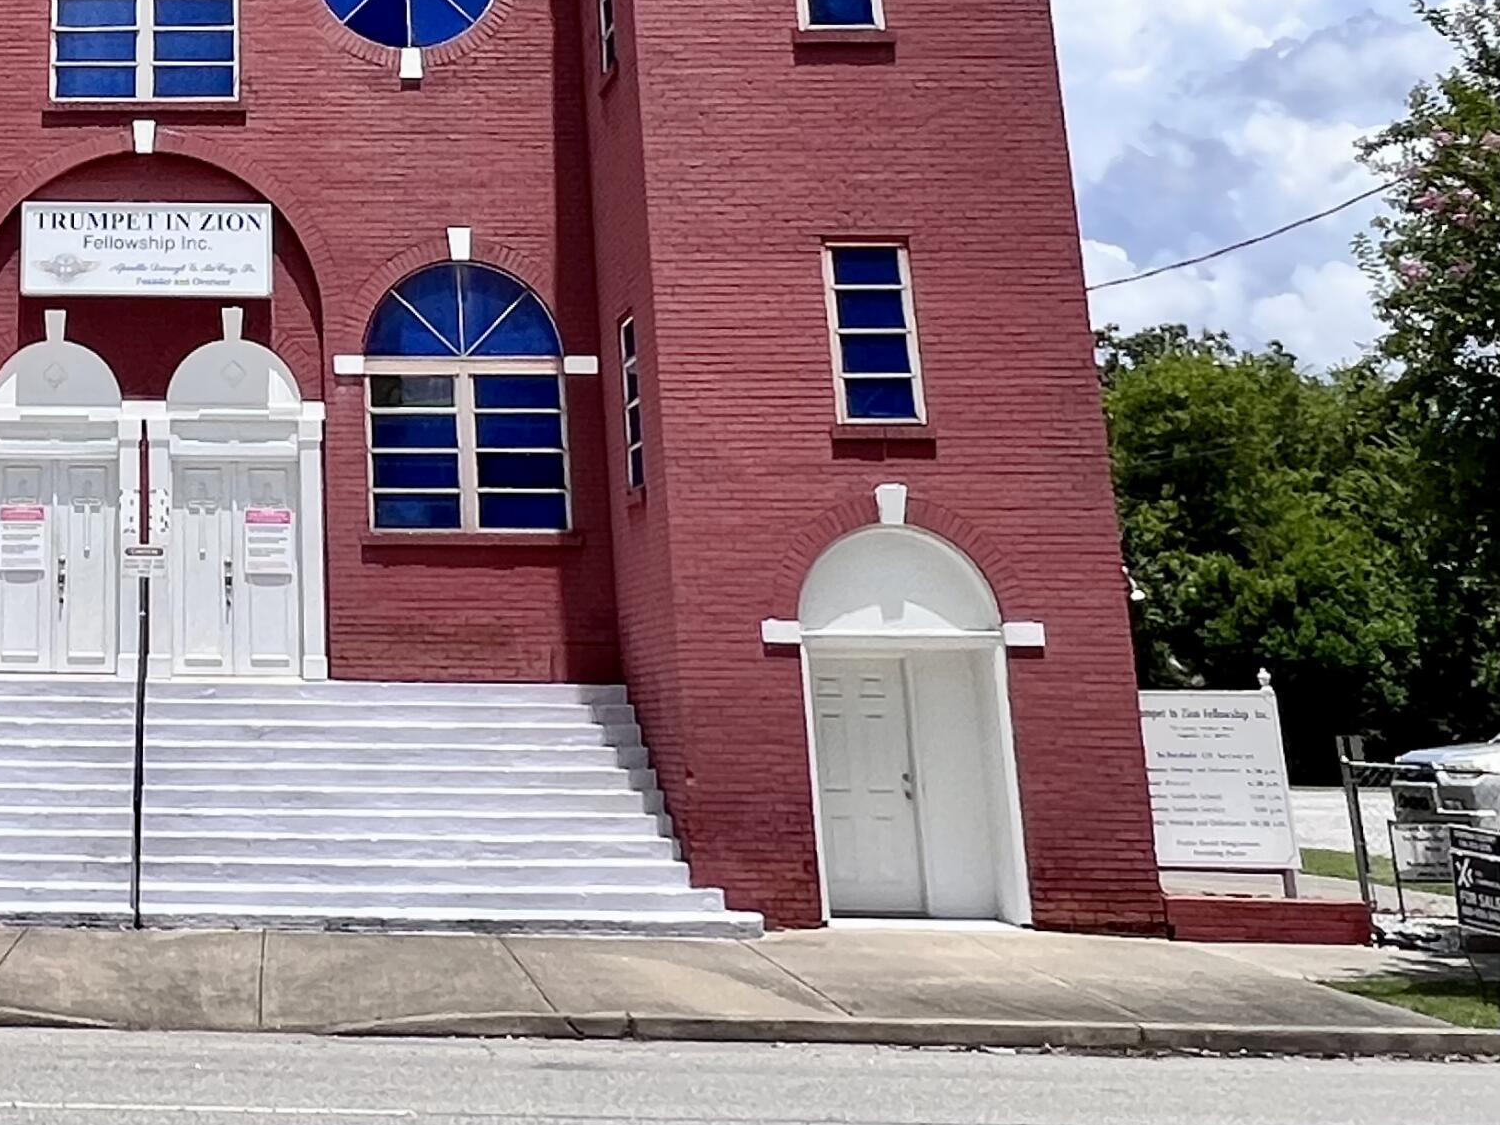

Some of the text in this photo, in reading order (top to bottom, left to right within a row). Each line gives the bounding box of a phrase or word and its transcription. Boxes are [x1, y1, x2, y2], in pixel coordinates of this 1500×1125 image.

[33, 212, 262, 232] TRUMPET IN ZION
[83, 235, 212, 253] Fellowship Inc.
